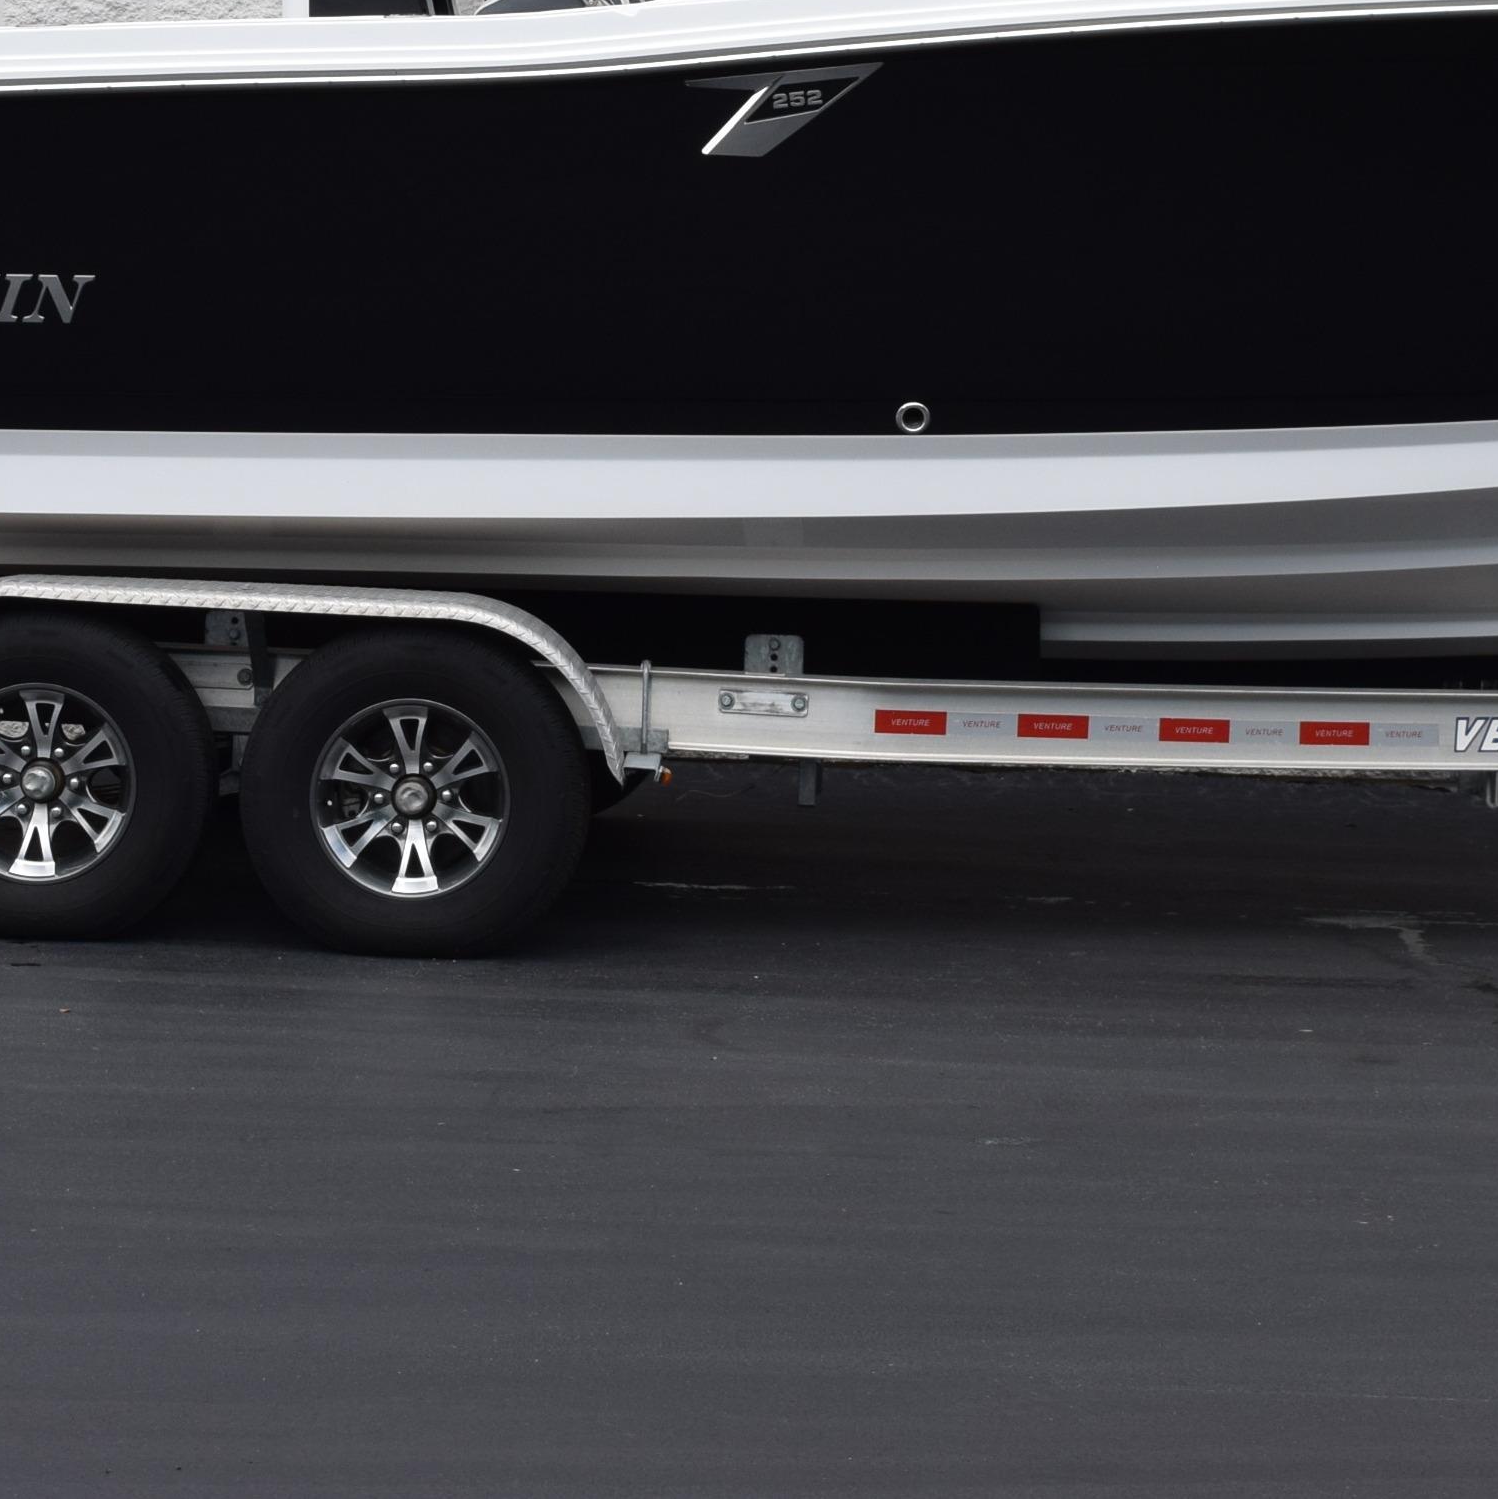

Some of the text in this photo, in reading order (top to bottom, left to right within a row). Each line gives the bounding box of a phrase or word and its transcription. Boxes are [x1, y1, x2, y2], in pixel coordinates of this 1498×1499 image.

[772, 89, 823, 109] 252
[891, 718, 1424, 738] VENTURE VENTURE VENTURE VENTURE VENTURE VENTURE VENTURE VENTURE
